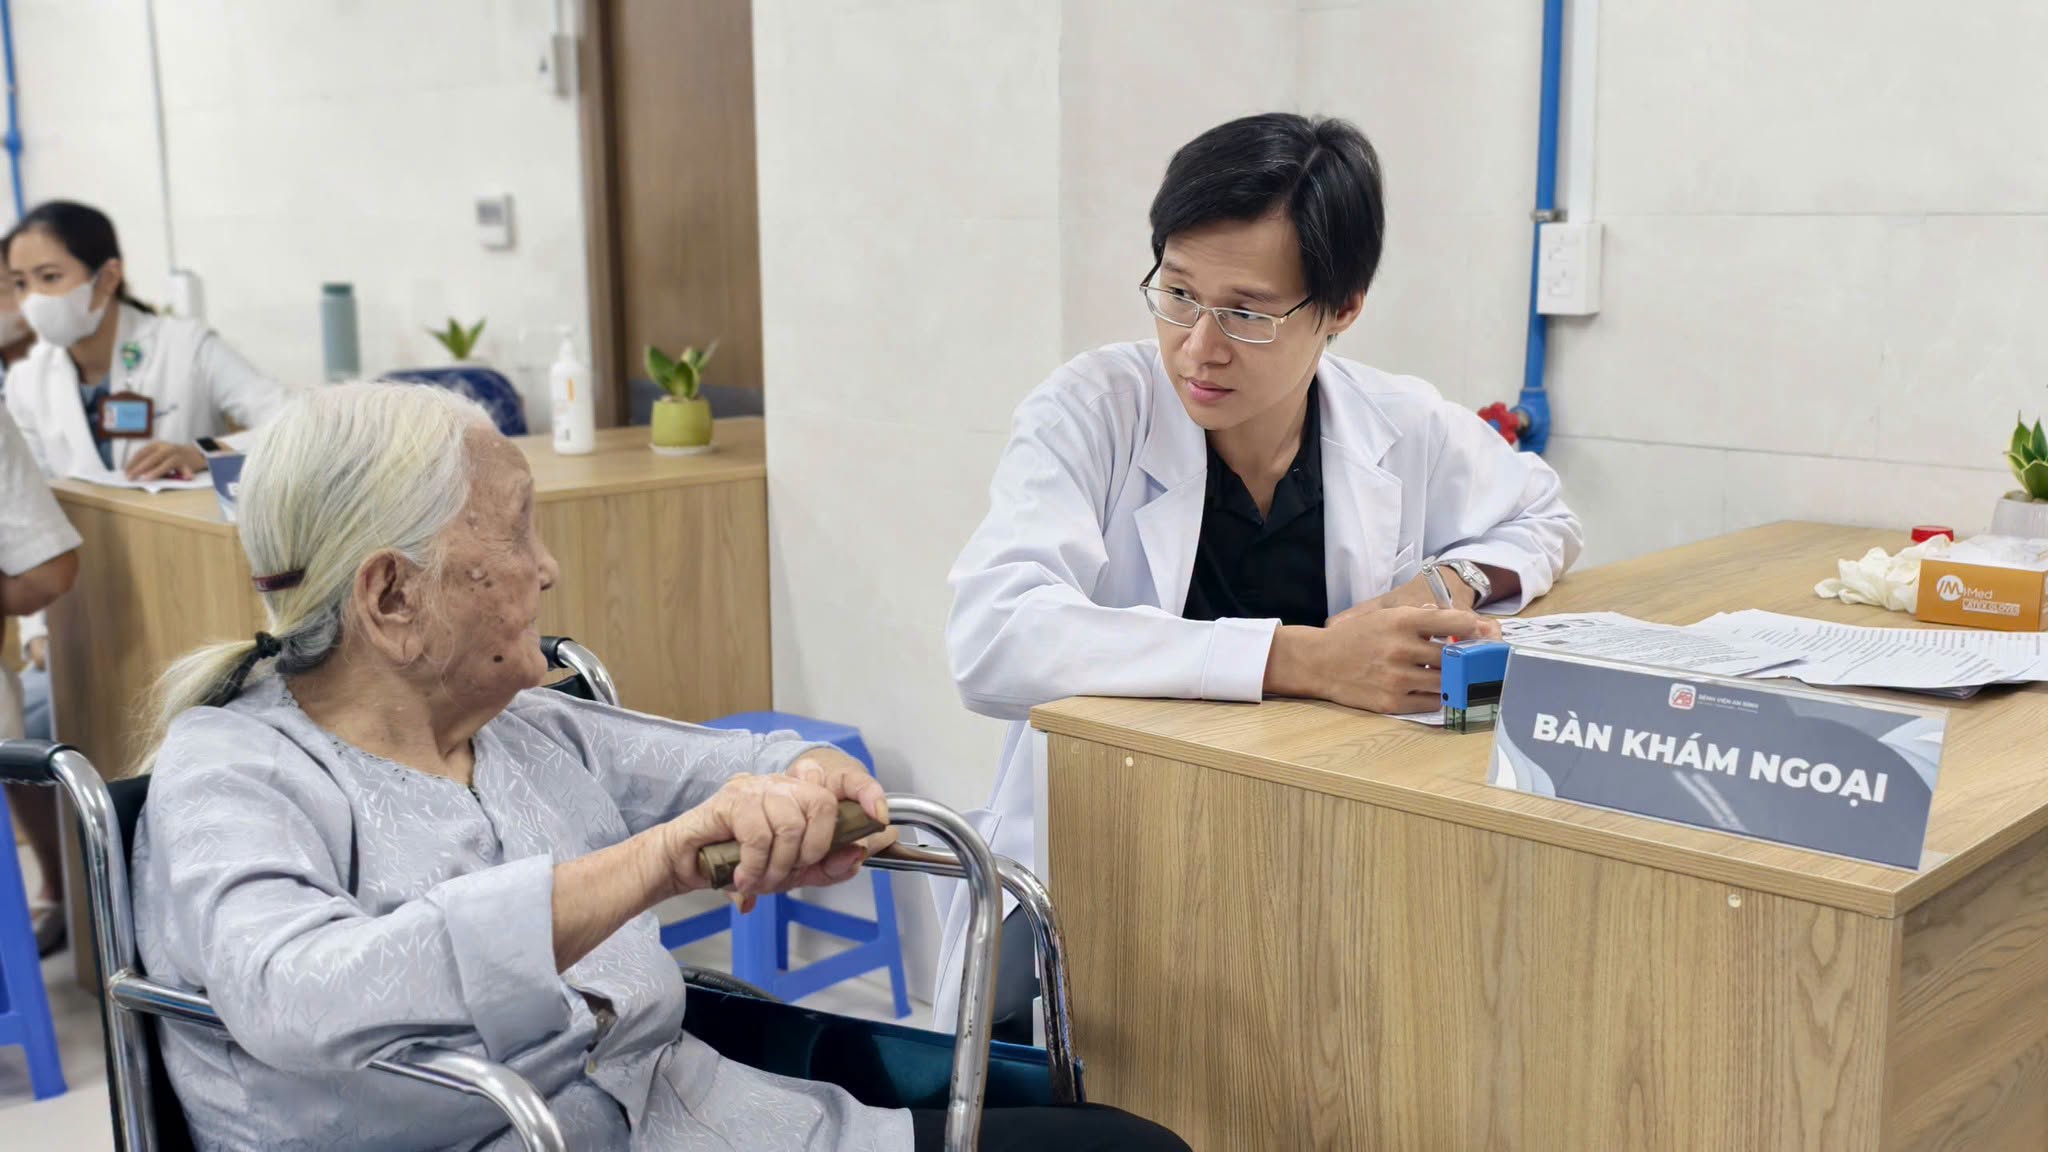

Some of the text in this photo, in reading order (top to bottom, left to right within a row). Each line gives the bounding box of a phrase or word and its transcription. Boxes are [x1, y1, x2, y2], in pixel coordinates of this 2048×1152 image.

[1532, 711, 1888, 807] BÀN KHÁM NGOẠI
